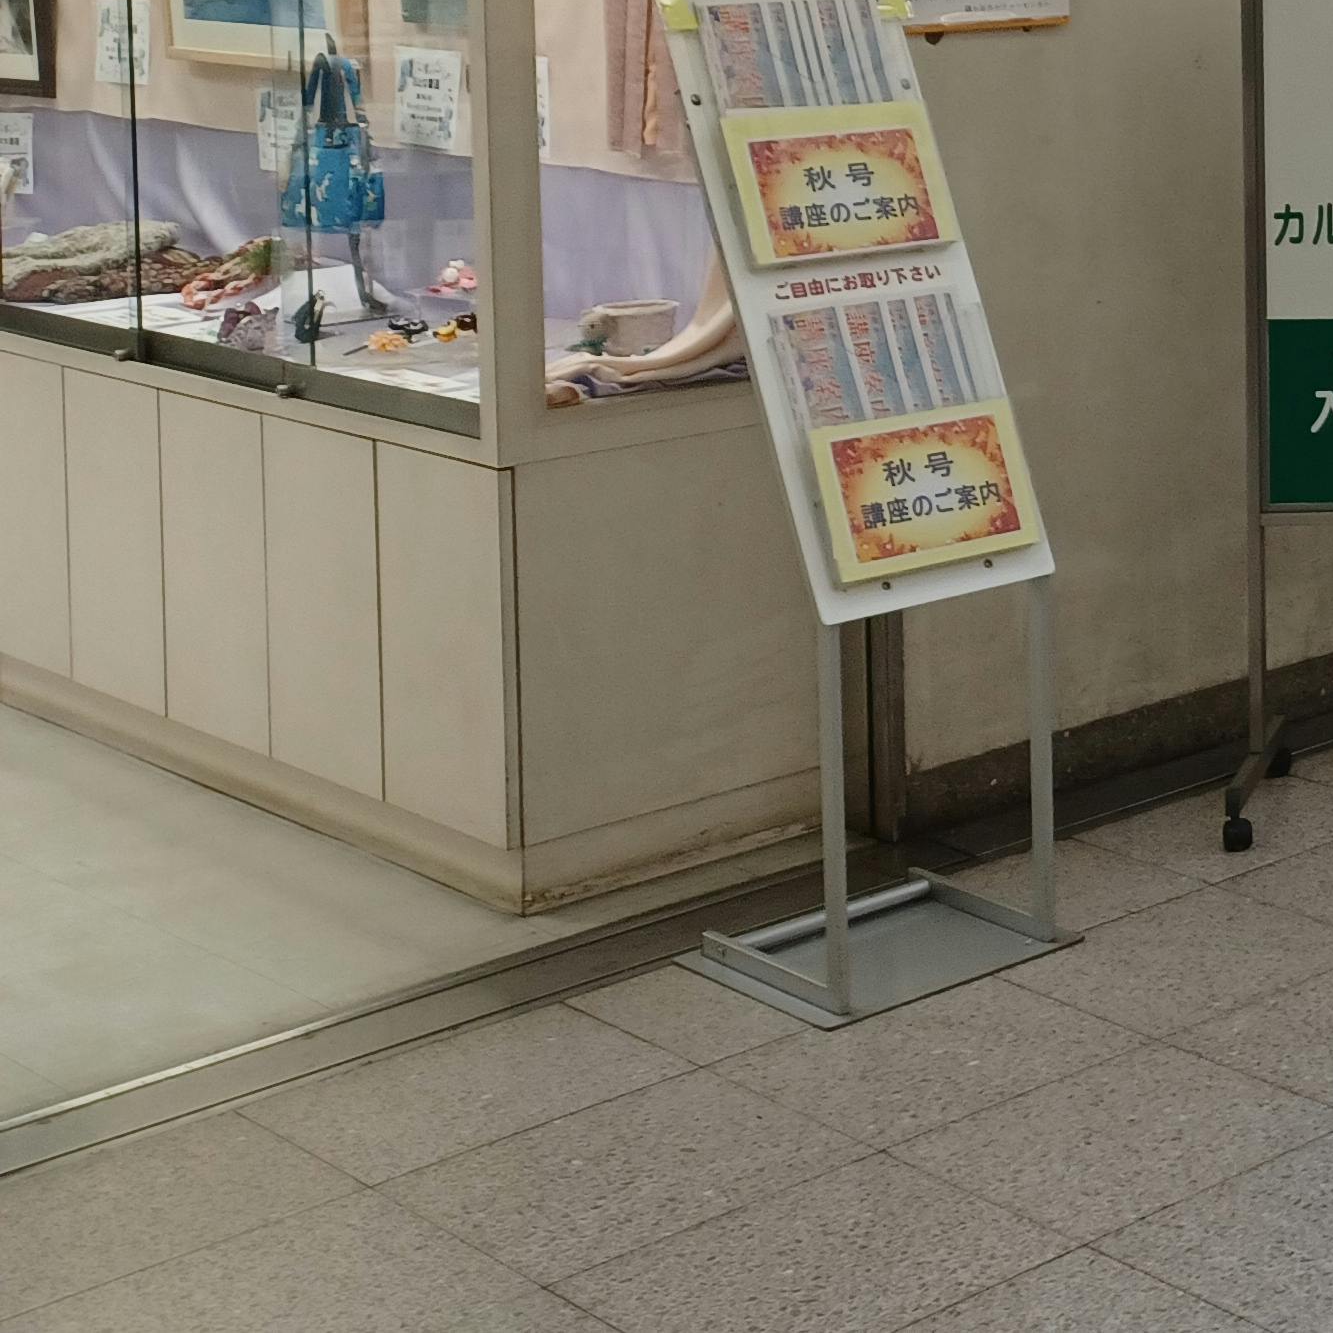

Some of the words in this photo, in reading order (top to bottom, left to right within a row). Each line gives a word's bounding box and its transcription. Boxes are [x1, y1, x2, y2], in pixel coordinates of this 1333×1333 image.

[778, 193, 920, 232] 講座のご案内
[775, 265, 942, 300] ご自由にお取り下さい
[860, 480, 1002, 530] 講座のご案内
